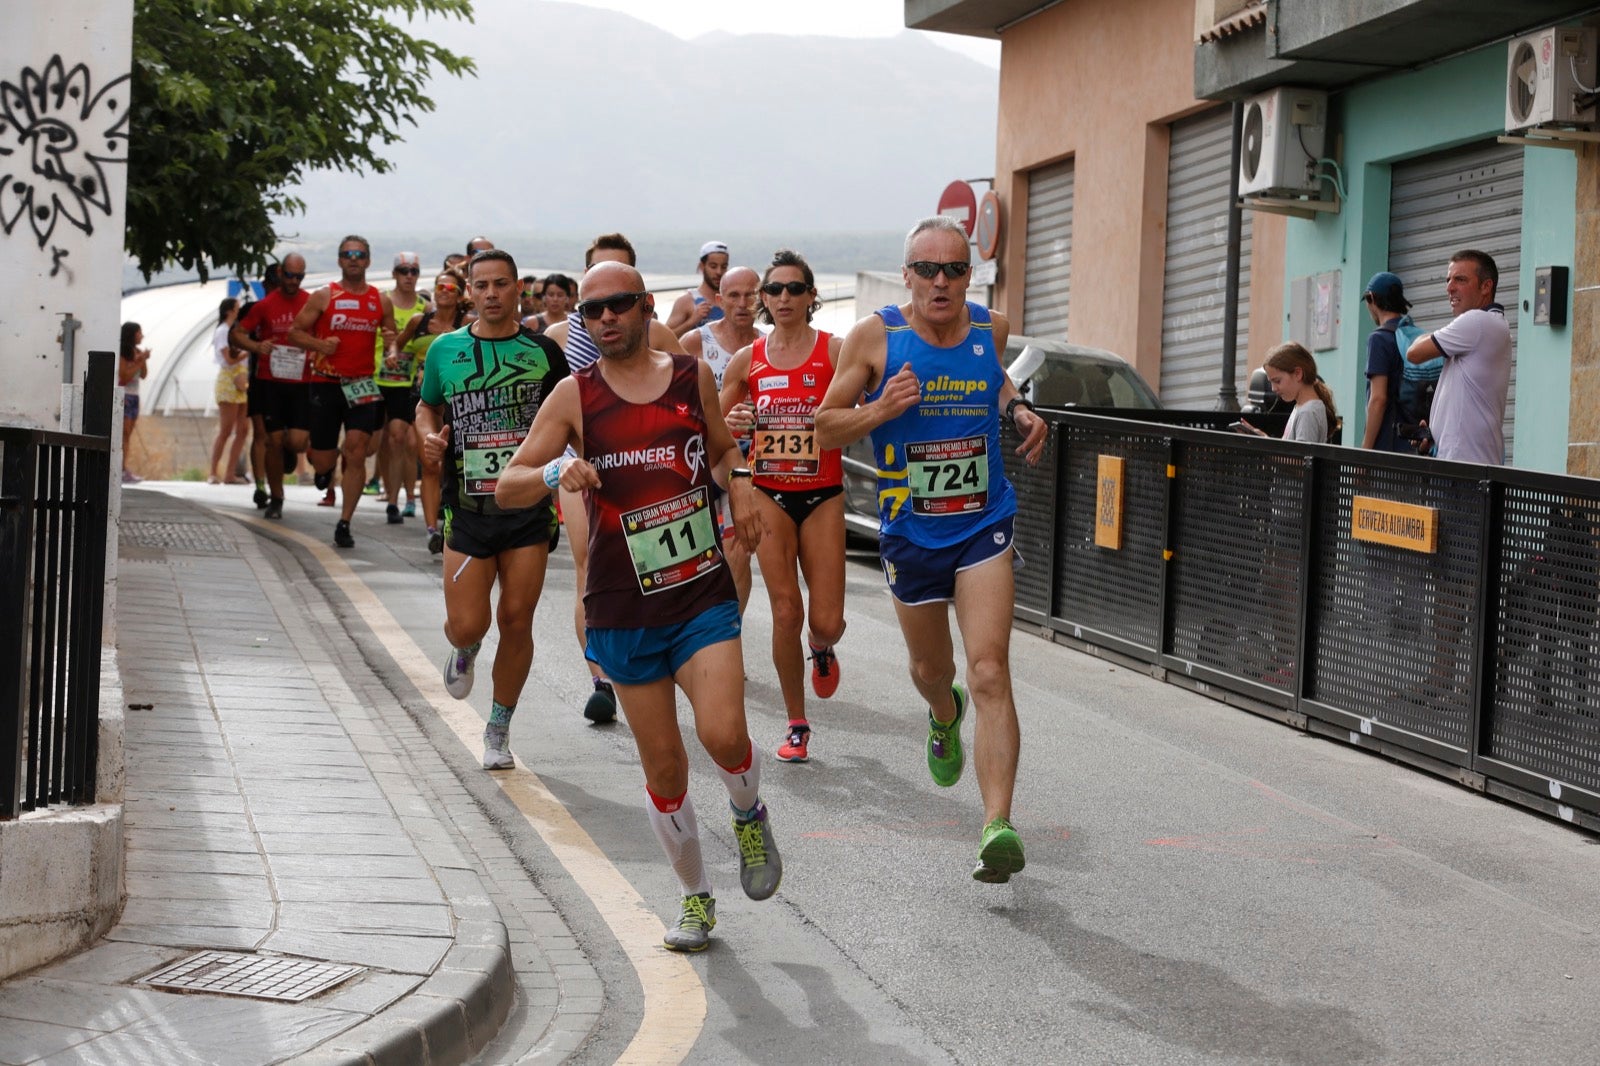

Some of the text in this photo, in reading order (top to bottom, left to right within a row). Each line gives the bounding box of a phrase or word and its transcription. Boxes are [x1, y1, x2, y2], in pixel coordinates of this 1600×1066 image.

[351, 380, 375, 396] 615
[926, 375, 988, 396] olimpo
[451, 391, 486, 419] TEAM
[923, 393, 964, 403] deportes
[470, 412, 483, 426] DE
[484, 407, 521, 422] MENTE
[919, 408, 988, 417] TRAIL & RUNNING
[763, 434, 813, 454] 2131
[925, 443, 941, 453] GRAN
[941, 440, 962, 452] PREMIO
[962, 440, 969, 450] DE
[968, 438, 983, 449] FONDO
[644, 460, 676, 472] GRANADA
[923, 460, 980, 492] 724
[642, 507, 660, 521] GRAN
[659, 499, 682, 515] PREMIO
[680, 497, 690, 507] DE
[1358, 508, 1425, 541] CERVEZAS ALHAMBRA
[658, 520, 698, 558] 11
